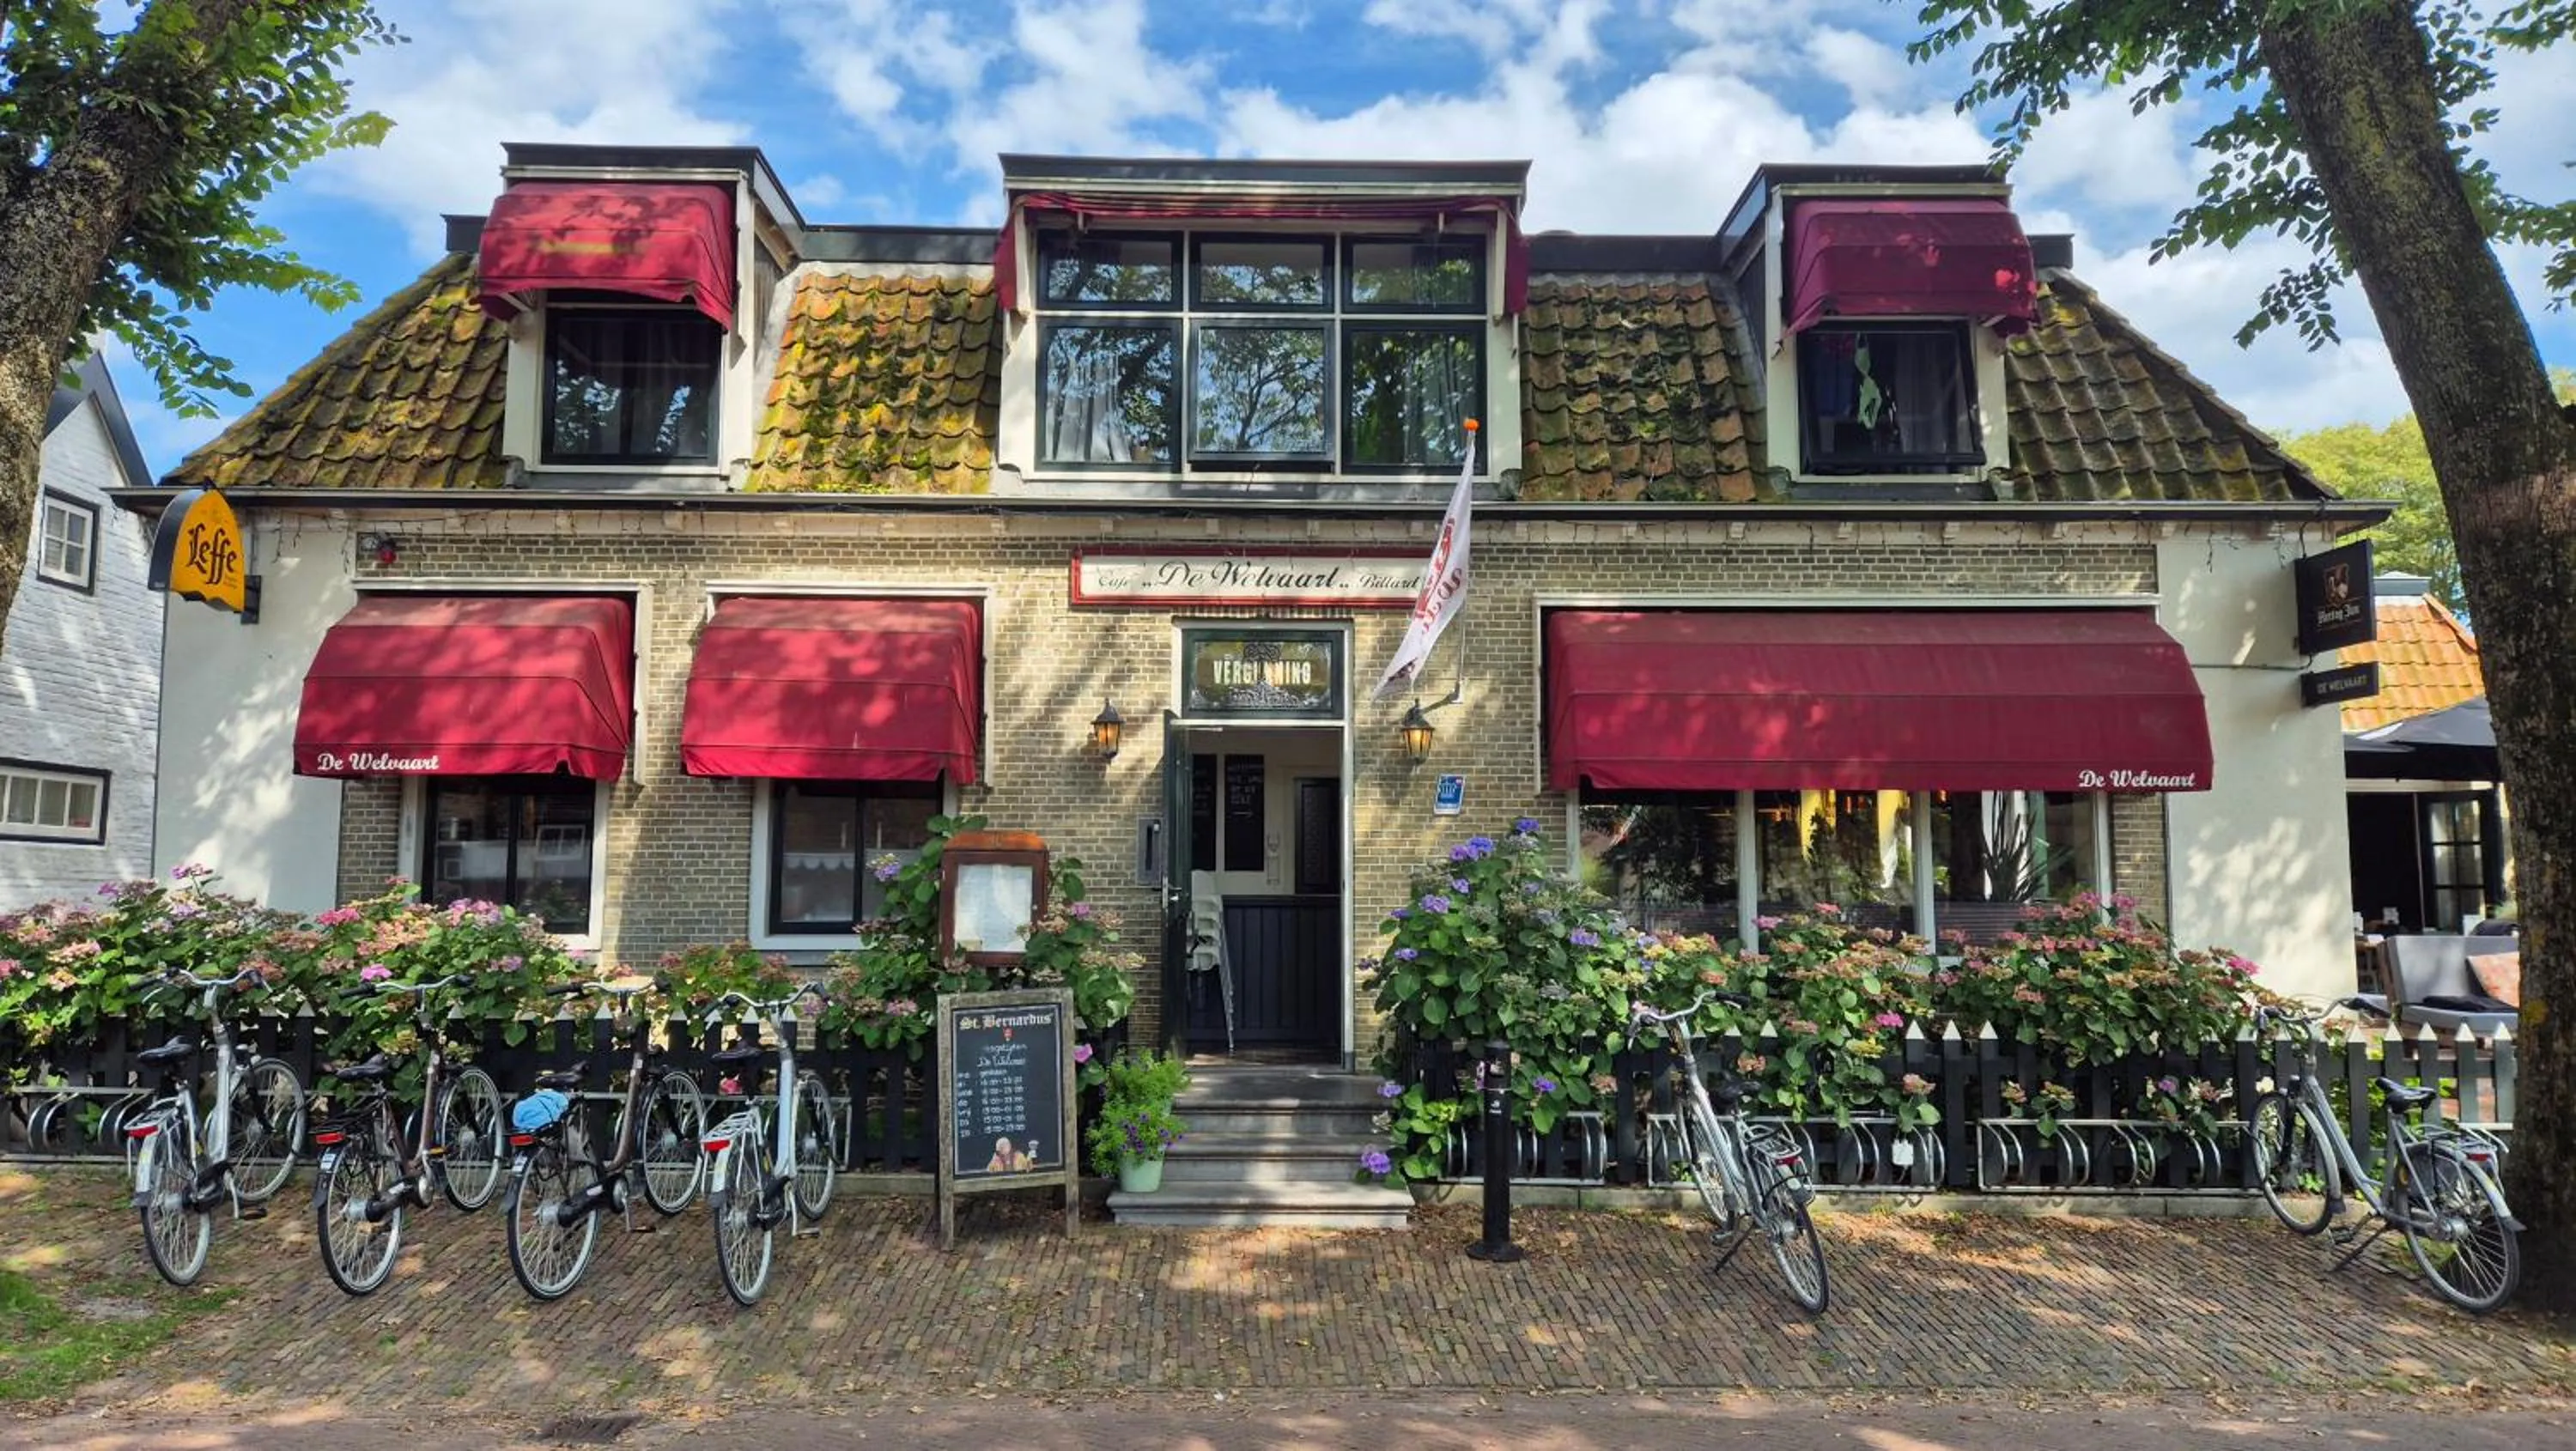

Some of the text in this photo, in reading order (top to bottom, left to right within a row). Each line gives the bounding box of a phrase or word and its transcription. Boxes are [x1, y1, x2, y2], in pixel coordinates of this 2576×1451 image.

[185, 523, 237, 585] Leffe
[317, 753, 440, 770] De Welvaart
[2078, 770, 2196, 788] De Welvaart
[982, 1013, 1053, 1029] Bernardus
